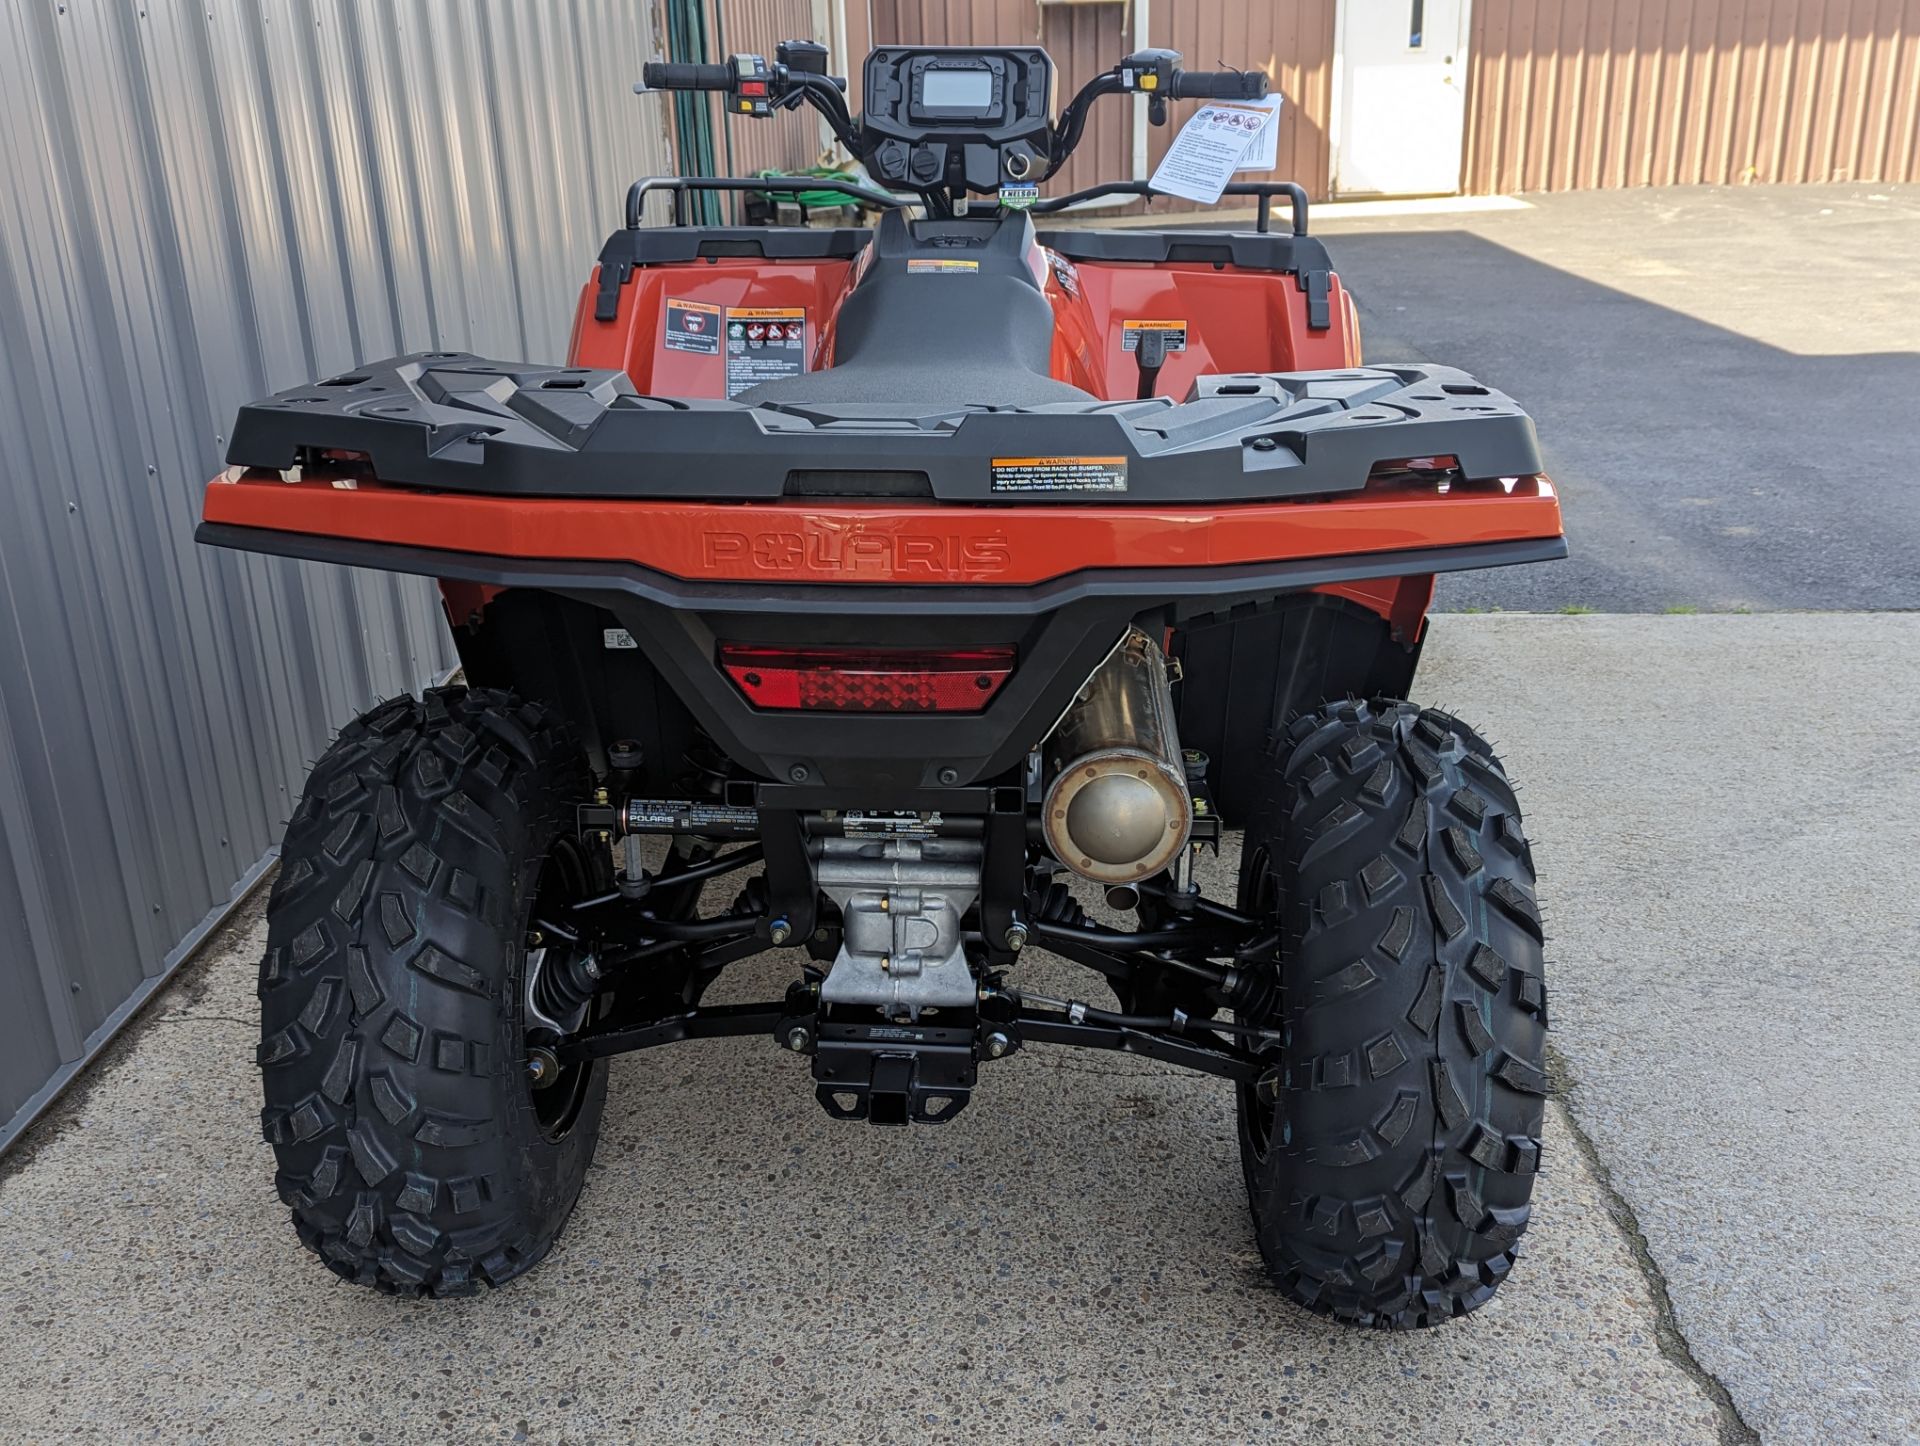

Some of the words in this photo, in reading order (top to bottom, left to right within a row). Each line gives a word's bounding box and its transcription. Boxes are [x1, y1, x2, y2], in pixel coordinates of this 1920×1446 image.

[688, 323, 699, 331] 16
[702, 531, 1012, 573] POLARIS
[630, 815, 675, 823] POLARIS
